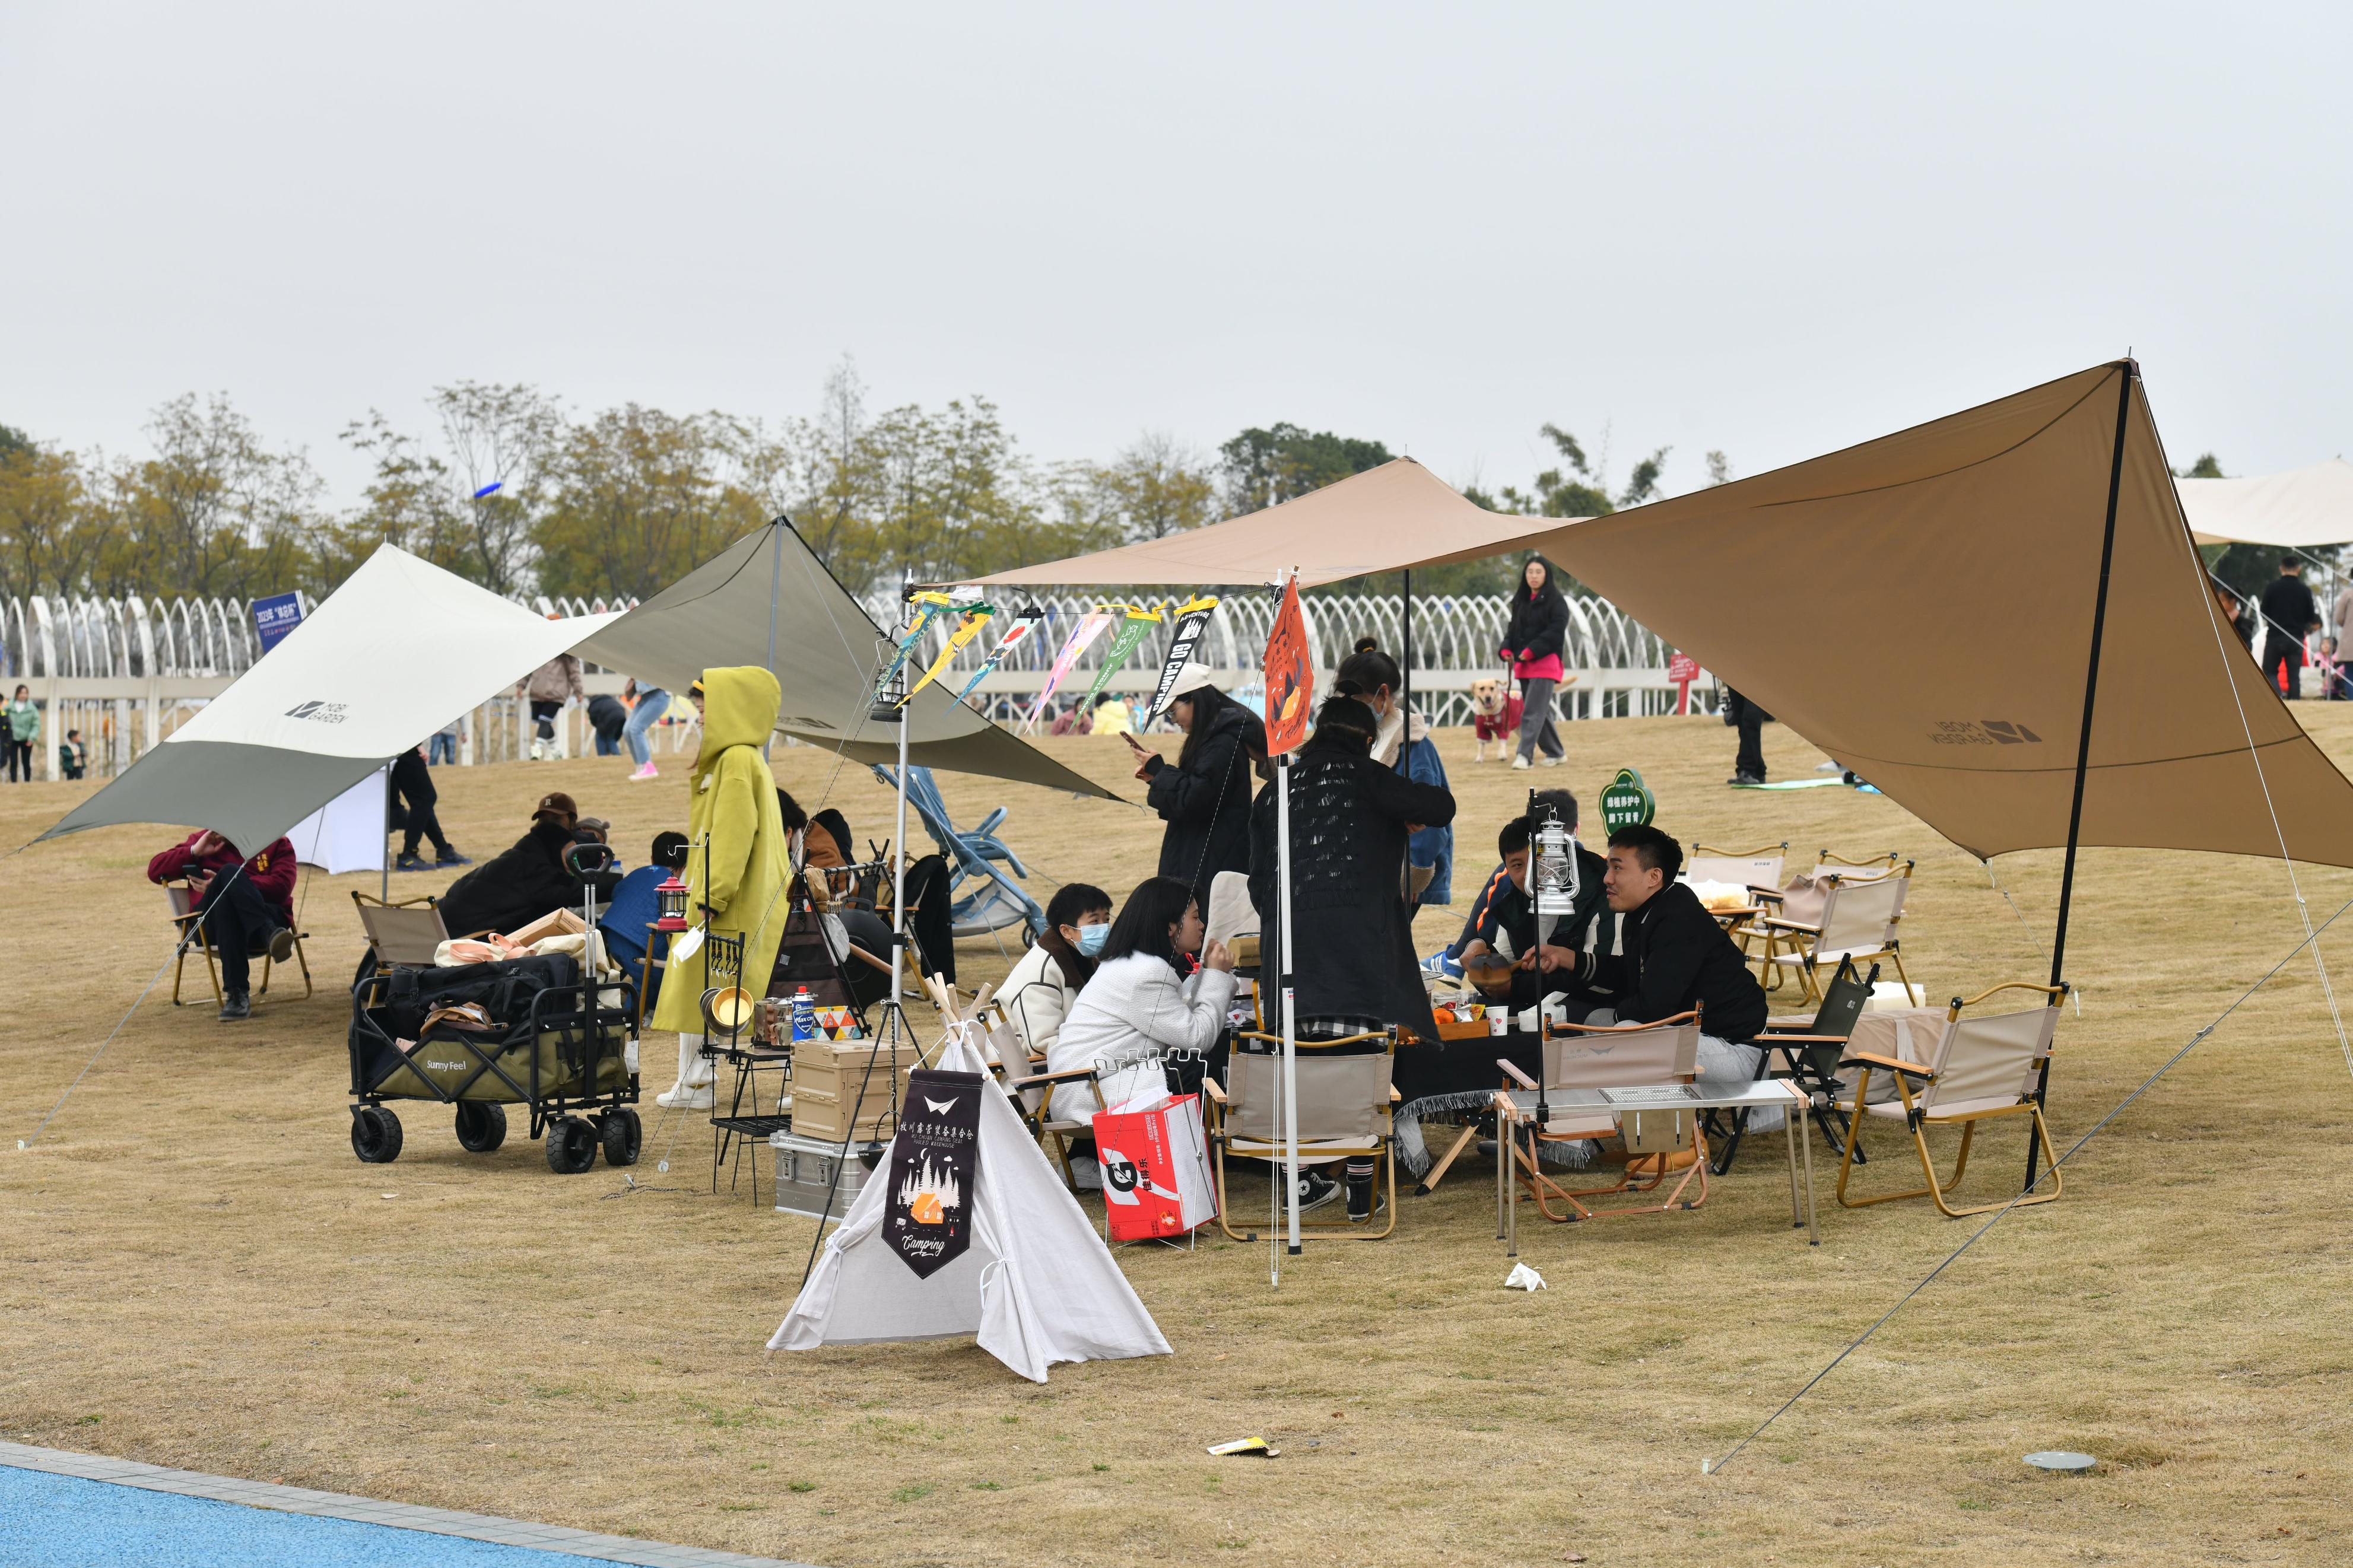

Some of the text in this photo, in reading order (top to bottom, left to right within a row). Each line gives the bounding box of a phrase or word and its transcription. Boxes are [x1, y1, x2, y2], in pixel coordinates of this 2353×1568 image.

[1180, 610, 1210, 623] ADVENTURE
[1094, 663, 1113, 691] JUNGLE
[1152, 643, 1192, 711] GO CAMPING
[1079, 692, 1094, 714] DIARY
[308, 711, 349, 724] GARDEN
[1607, 795, 1640, 808] 绿植养护中
[900, 1121, 973, 1140] 牧川露营装备集合仓
[1139, 1158, 1152, 1191] 佳得乐
[902, 1235, 945, 1257] Camping
